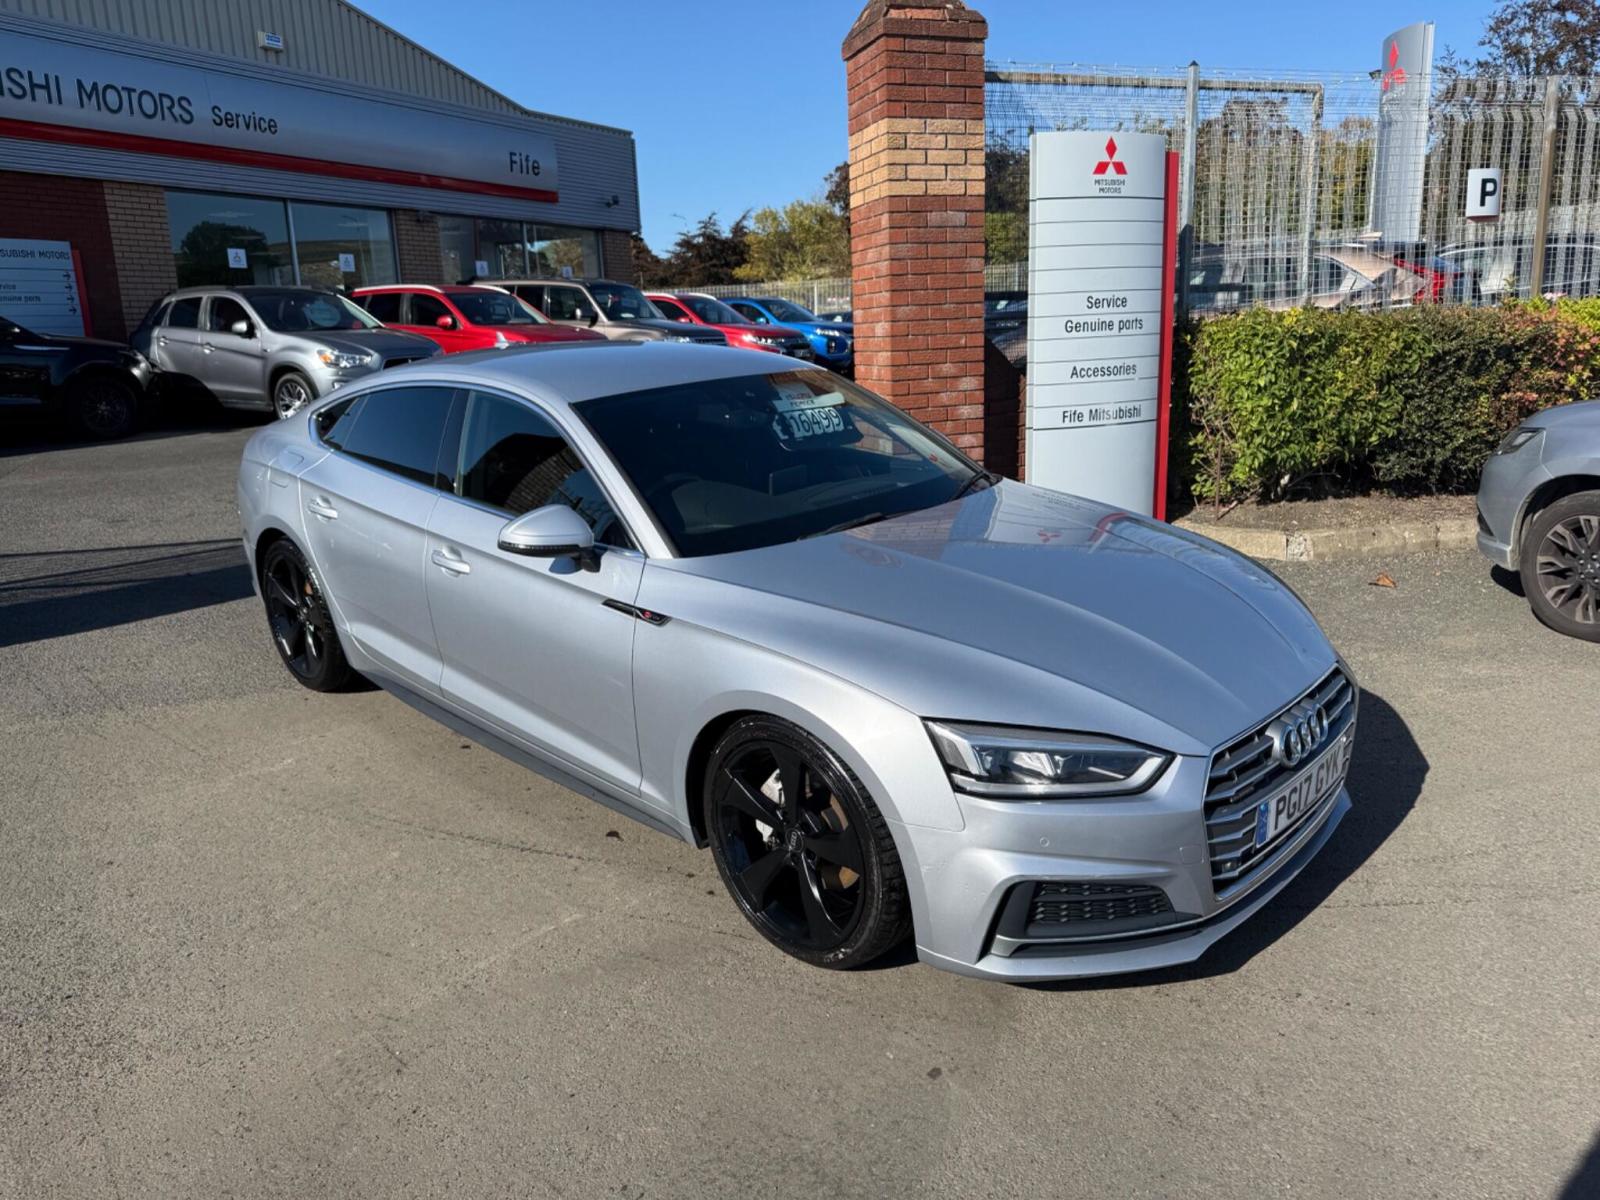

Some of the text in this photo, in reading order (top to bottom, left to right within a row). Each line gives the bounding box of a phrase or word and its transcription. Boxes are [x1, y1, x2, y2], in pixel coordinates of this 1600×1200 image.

[76, 77, 195, 125] MOTORS
[211, 105, 279, 136] Service
[509, 151, 541, 177] Fife
[1094, 178, 1126, 186] MITSUBISHI
[1098, 186, 1122, 194] MOTORS
[1480, 177, 1498, 207] P
[38, 249, 70, 260] MOTORS
[1086, 294, 1128, 310] Service
[1064, 317, 1144, 334] Genuine parts
[1070, 361, 1138, 379] Accessories
[1062, 404, 1142, 424] Fife Mitsubishi
[1274, 748, 1340, 832] PG17 GYK
